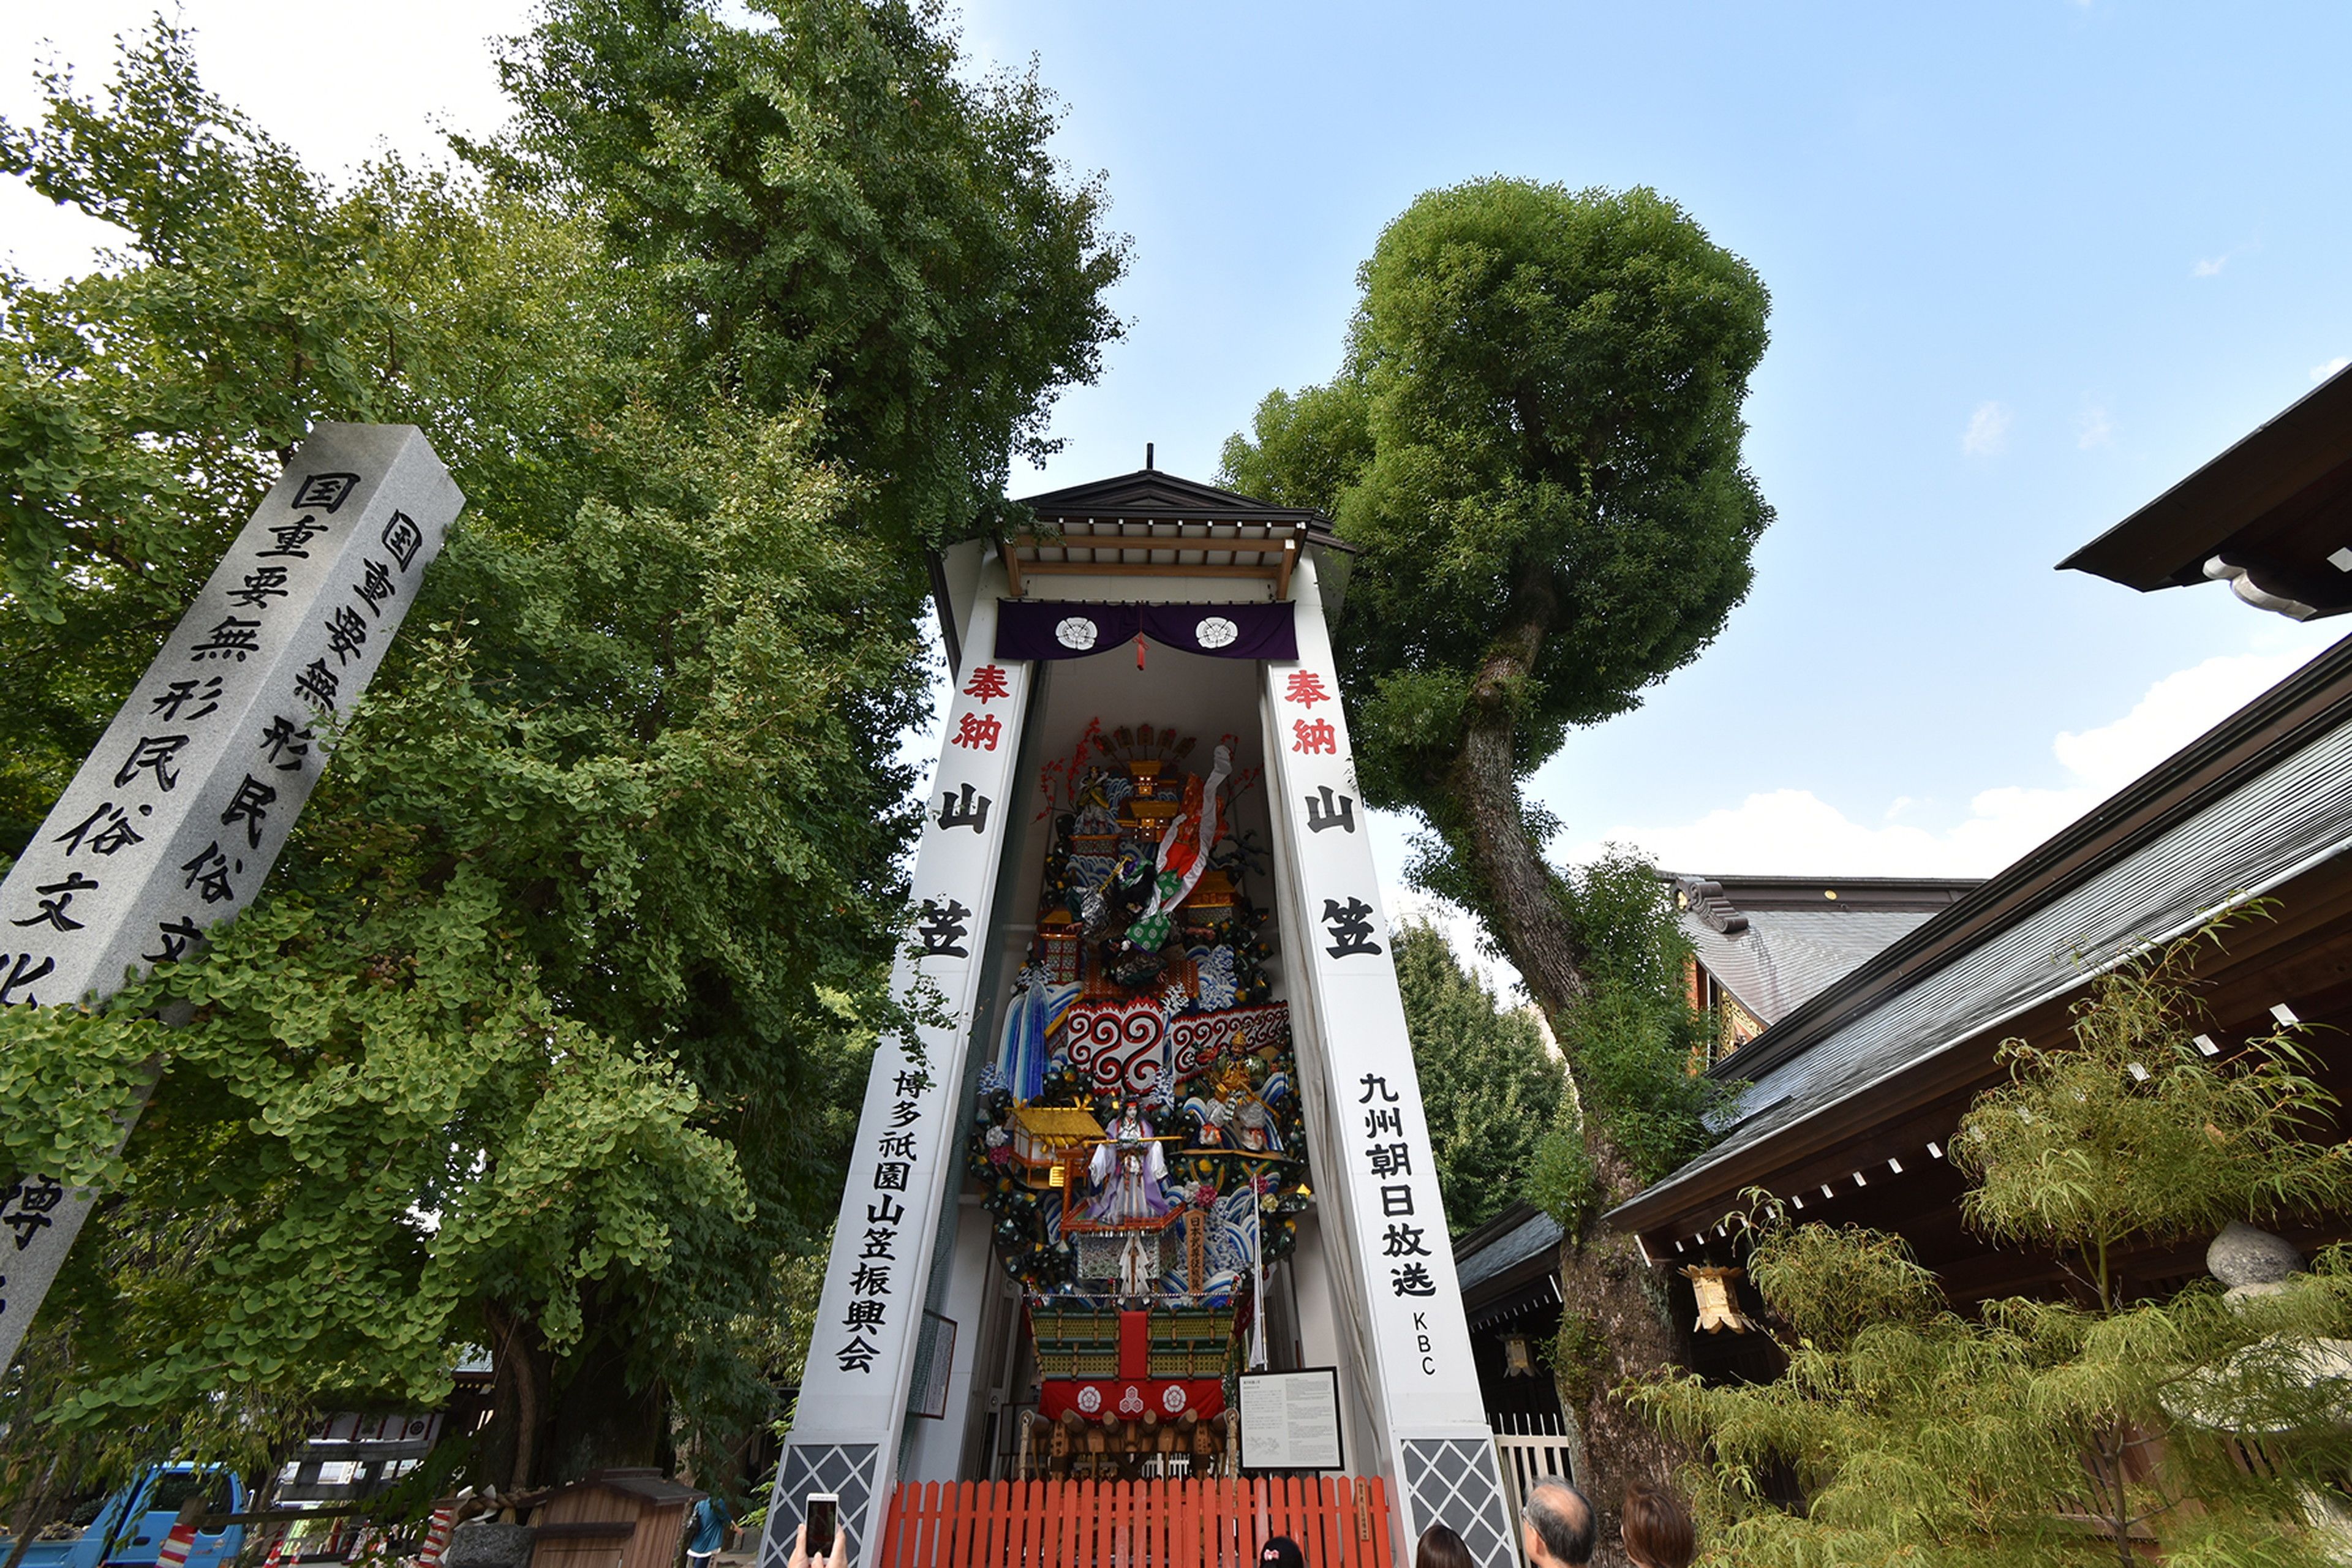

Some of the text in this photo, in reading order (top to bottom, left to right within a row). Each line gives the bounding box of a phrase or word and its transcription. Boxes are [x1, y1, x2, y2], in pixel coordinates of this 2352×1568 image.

[835, 664, 1009, 1373] 奉納 山笠 博多祇園山笠振興会
[1285, 669, 1436, 1376] 奉納 山笠 九州朝日放送 KBC
